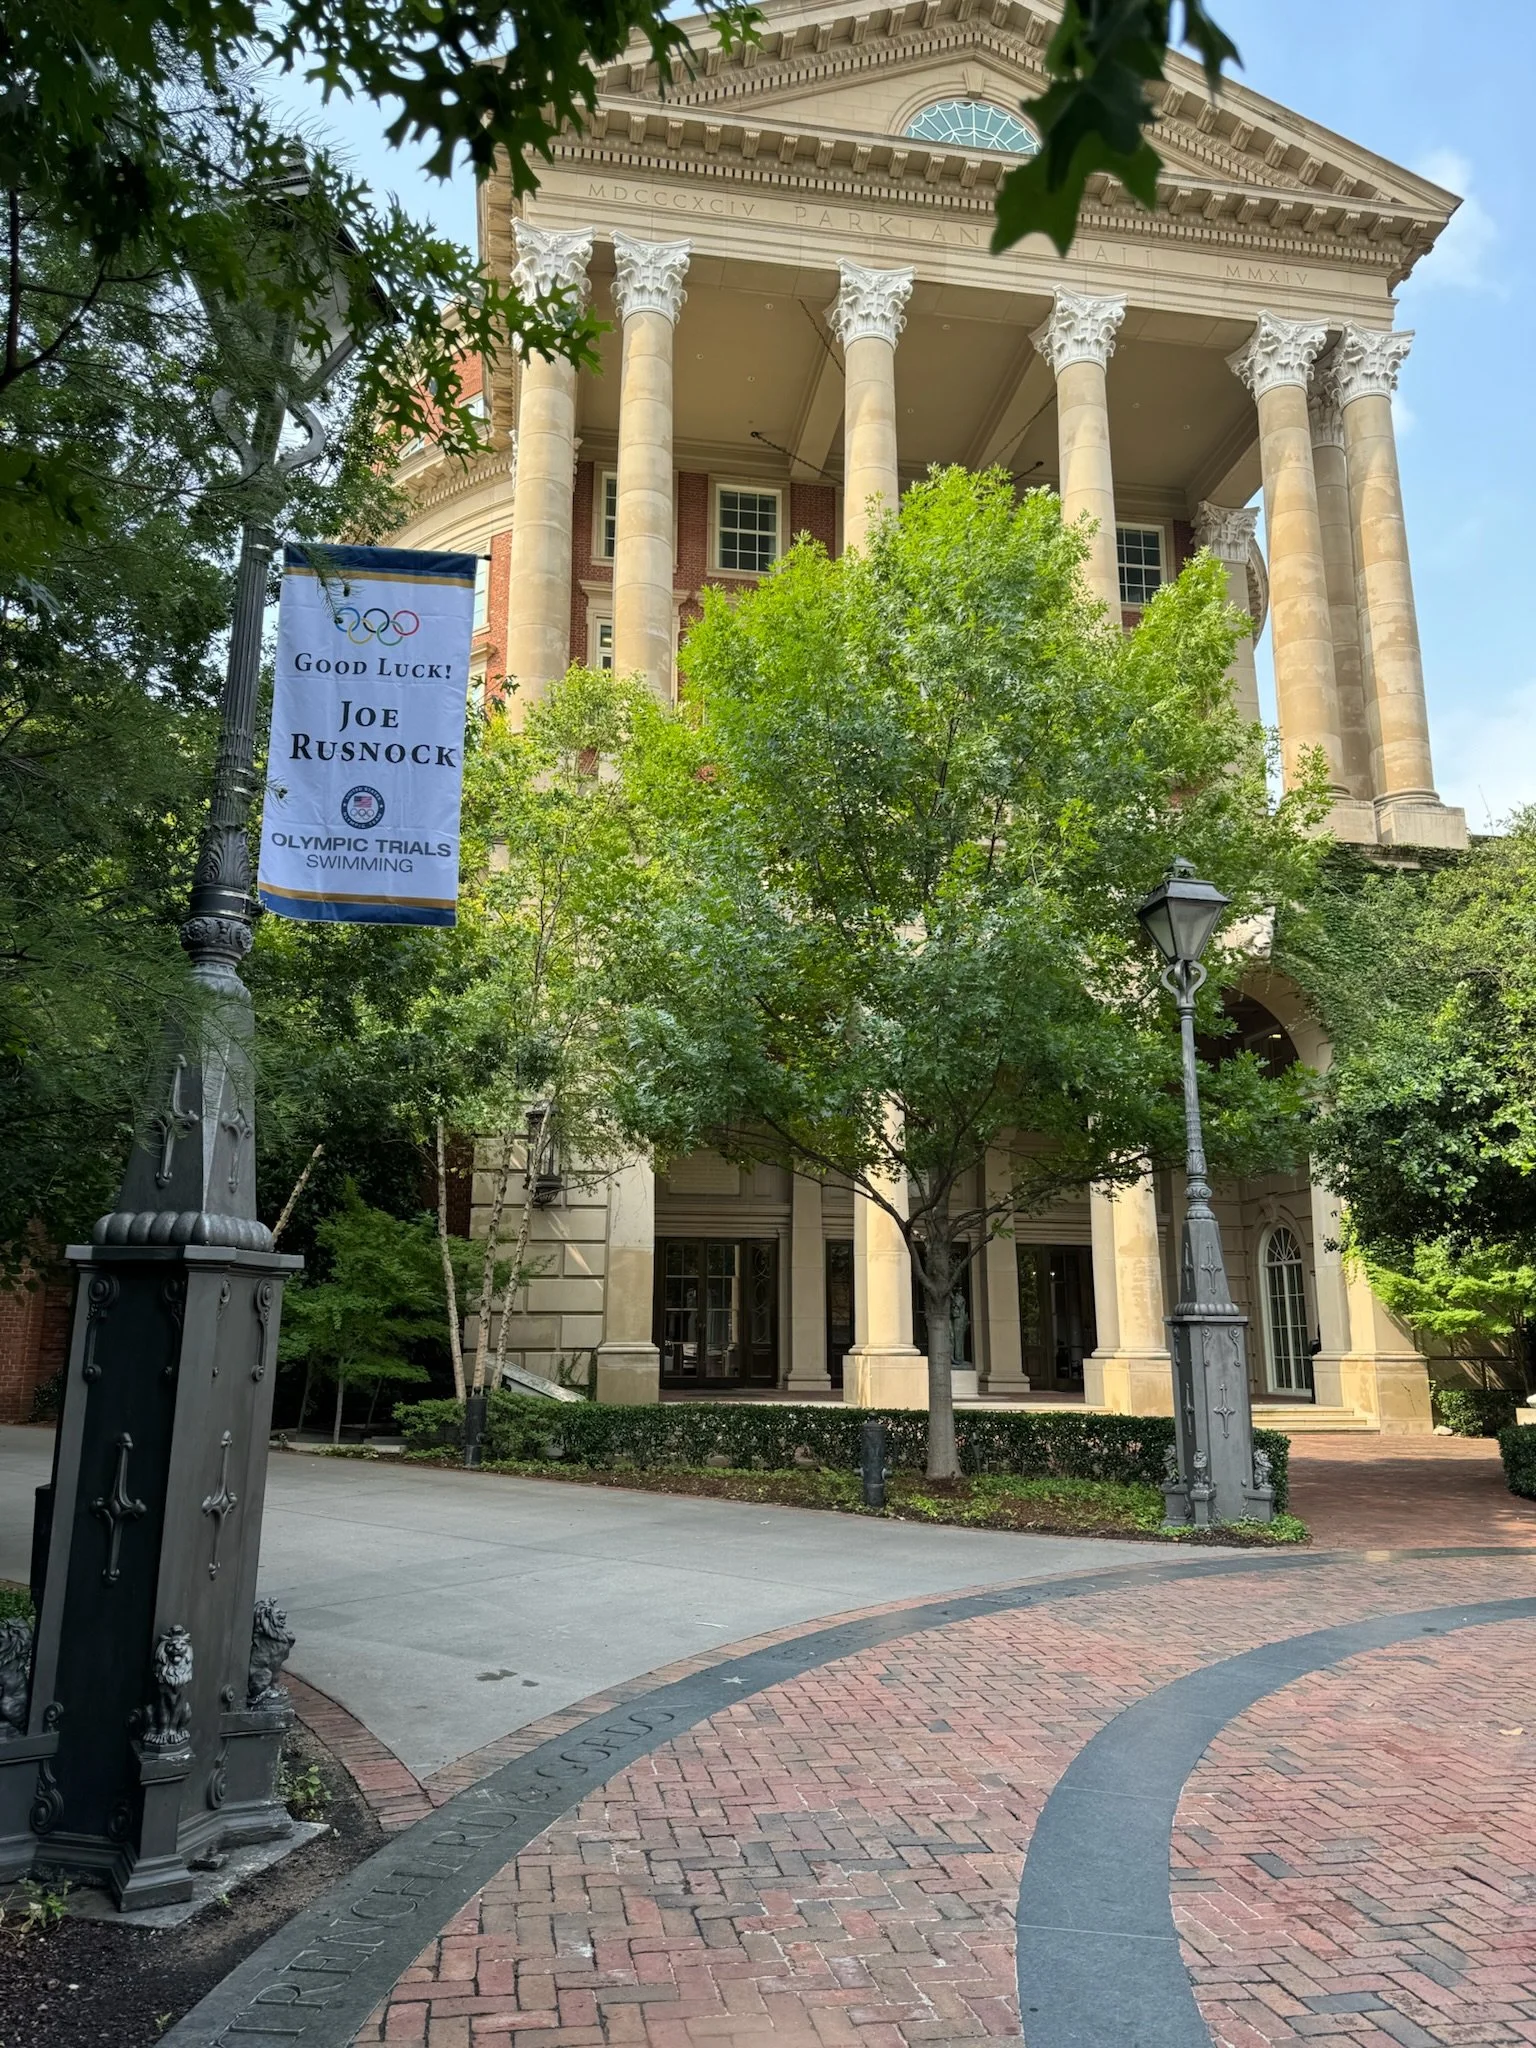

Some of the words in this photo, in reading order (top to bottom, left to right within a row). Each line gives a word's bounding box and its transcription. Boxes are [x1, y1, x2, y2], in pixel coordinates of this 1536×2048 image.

[588, 183, 755, 217] MDCCCXCIV
[1226, 263, 1308, 286] MMXIV
[271, 832, 369, 852] OLYMPIC
[375, 838, 452, 857] TRIALS
[306, 854, 413, 873] SWIMMING
